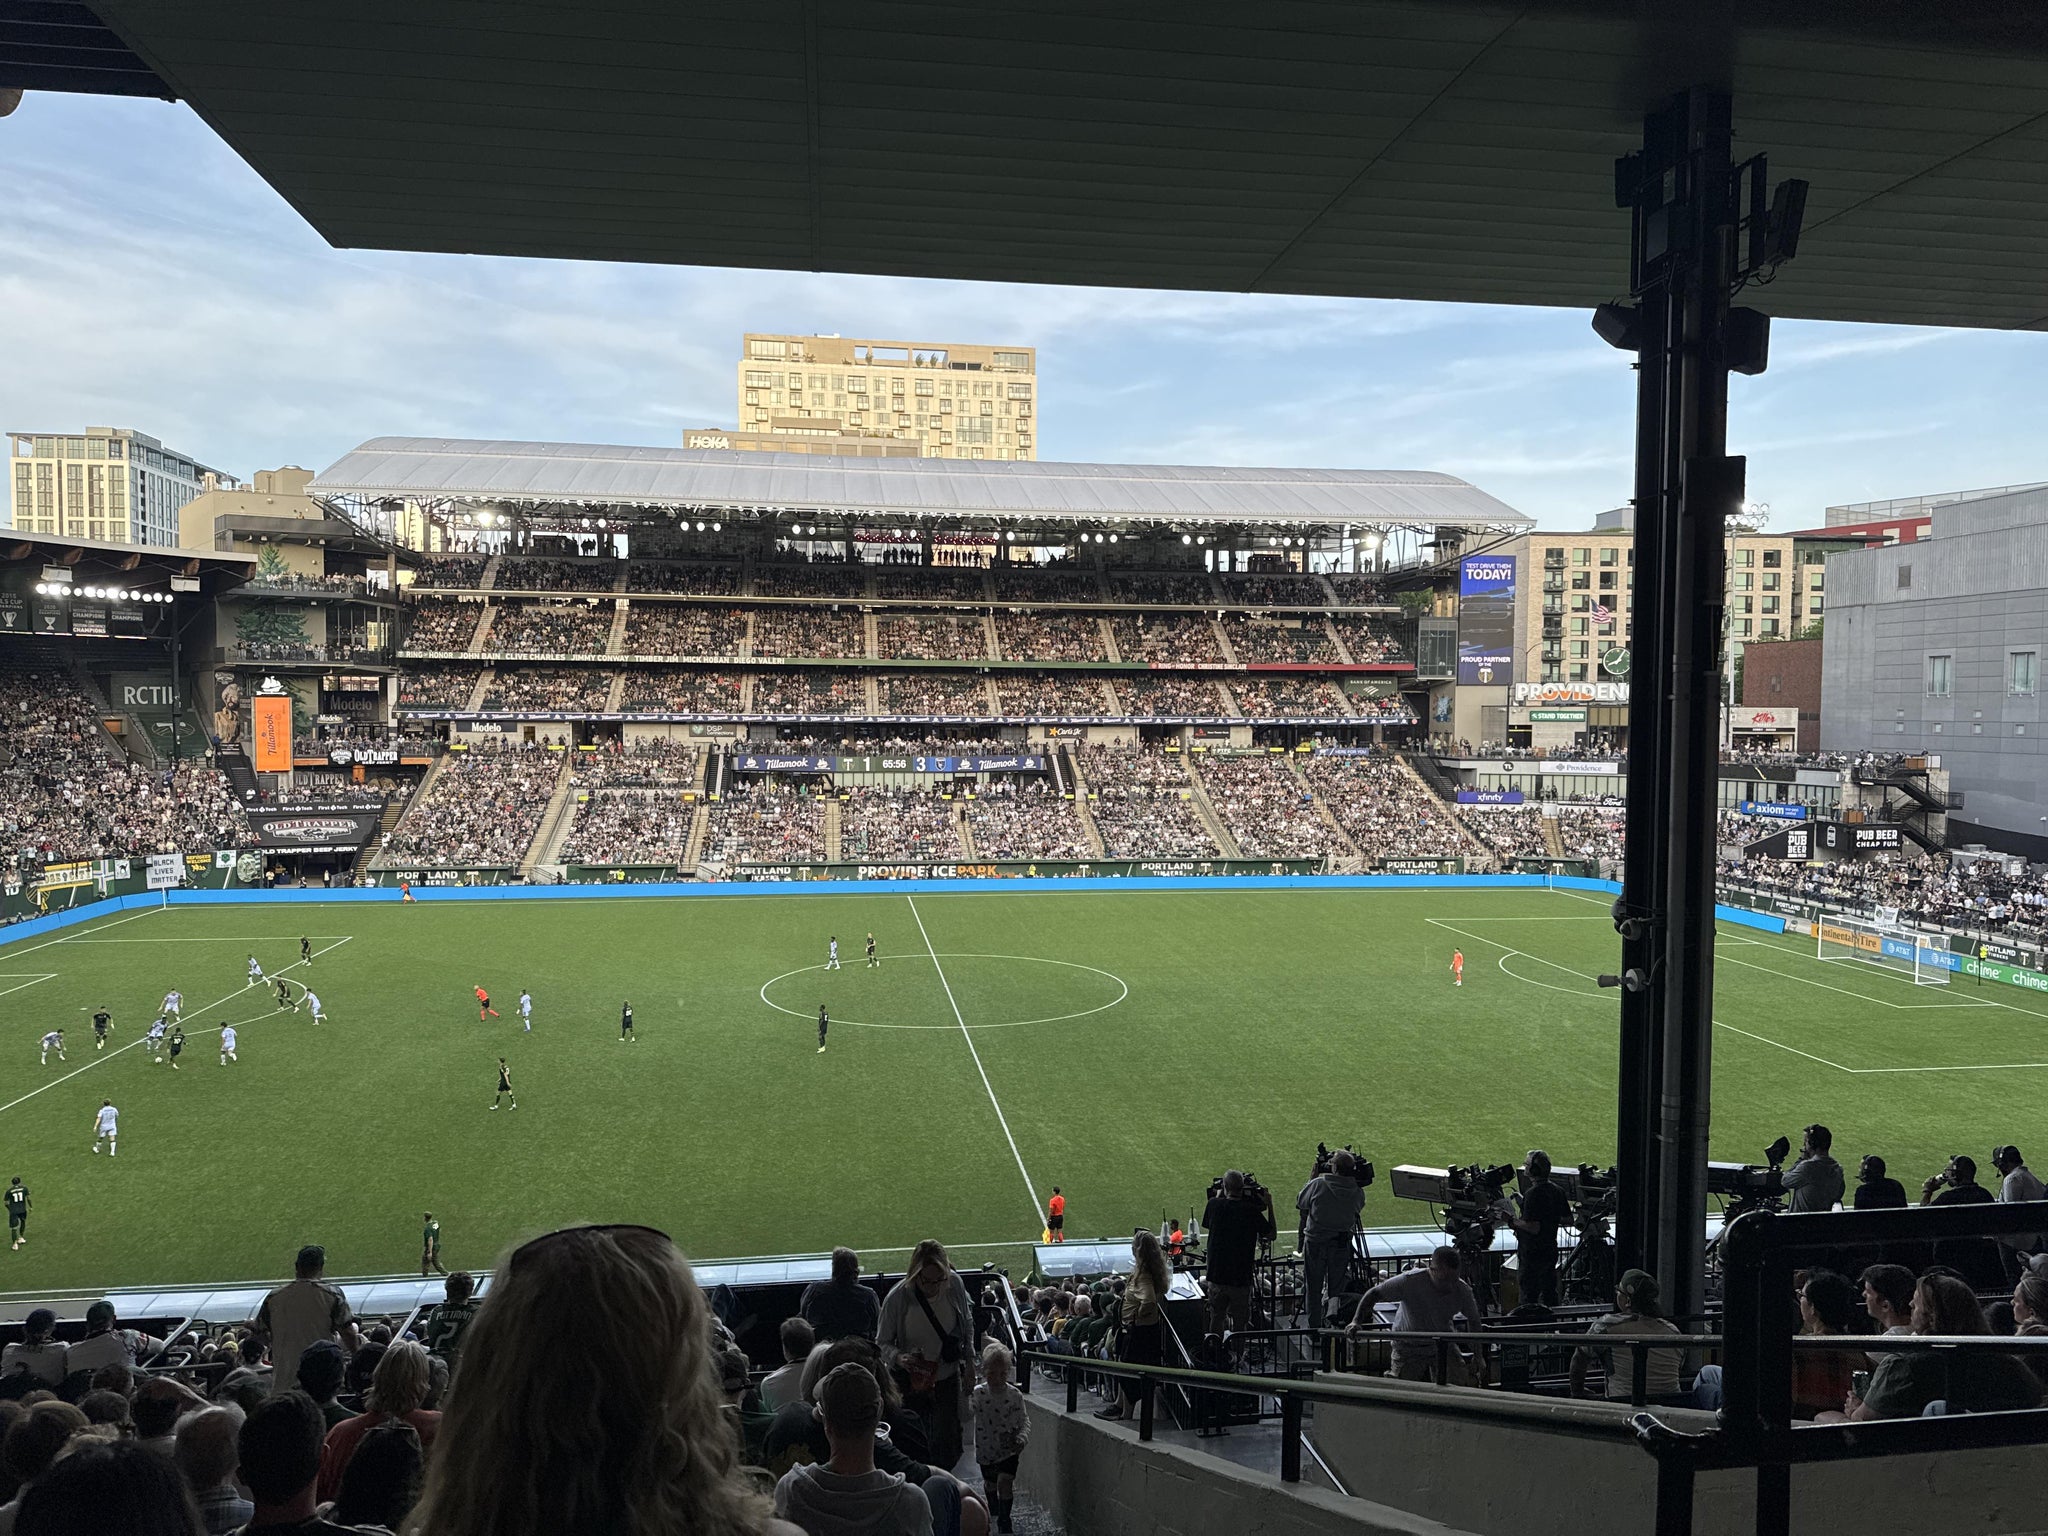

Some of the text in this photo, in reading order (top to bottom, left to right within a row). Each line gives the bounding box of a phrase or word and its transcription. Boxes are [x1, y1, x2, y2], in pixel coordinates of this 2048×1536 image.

[689, 435, 729, 449] HOKA
[1466, 569, 1511, 580] TODAY!
[481, 652, 500, 660] BAIN
[597, 654, 630, 662] CONWAY
[734, 656, 756, 664] DIEGO
[124, 686, 173, 704] RCTI
[330, 694, 372, 710] Modelo
[472, 722, 502, 732] Modelo
[267, 714, 276, 756] Tillamook
[766, 758, 808, 768] Tillamook
[863, 758, 870, 770] 1
[882, 760, 906, 768] 65:56
[916, 757, 926, 772] 3
[979, 758, 1018, 770] Tillamook
[1566, 764, 1602, 772] Providence
[1477, 793, 1503, 802] xfinity
[1603, 798, 1622, 806] Ford
[1756, 804, 1784, 814] axiom
[266, 820, 354, 831] OLD TRAPPER
[1856, 830, 1898, 840] PUB BEER
[1788, 836, 1807, 846] PUB
[1788, 846, 1806, 854] BEER
[957, 866, 997, 876] PARK
[1142, 862, 1194, 870] PORTLAND
[152, 876, 178, 884] MATTER
[396, 871, 458, 879] PORLAND
[1860, 936, 1876, 948] Tire
[1896, 946, 1910, 955] AT&T
[1940, 956, 1955, 966] AT&T
[1966, 961, 2000, 978] chime
[2012, 972, 2048, 990] chime
[12, 1192, 24, 1202] 11
